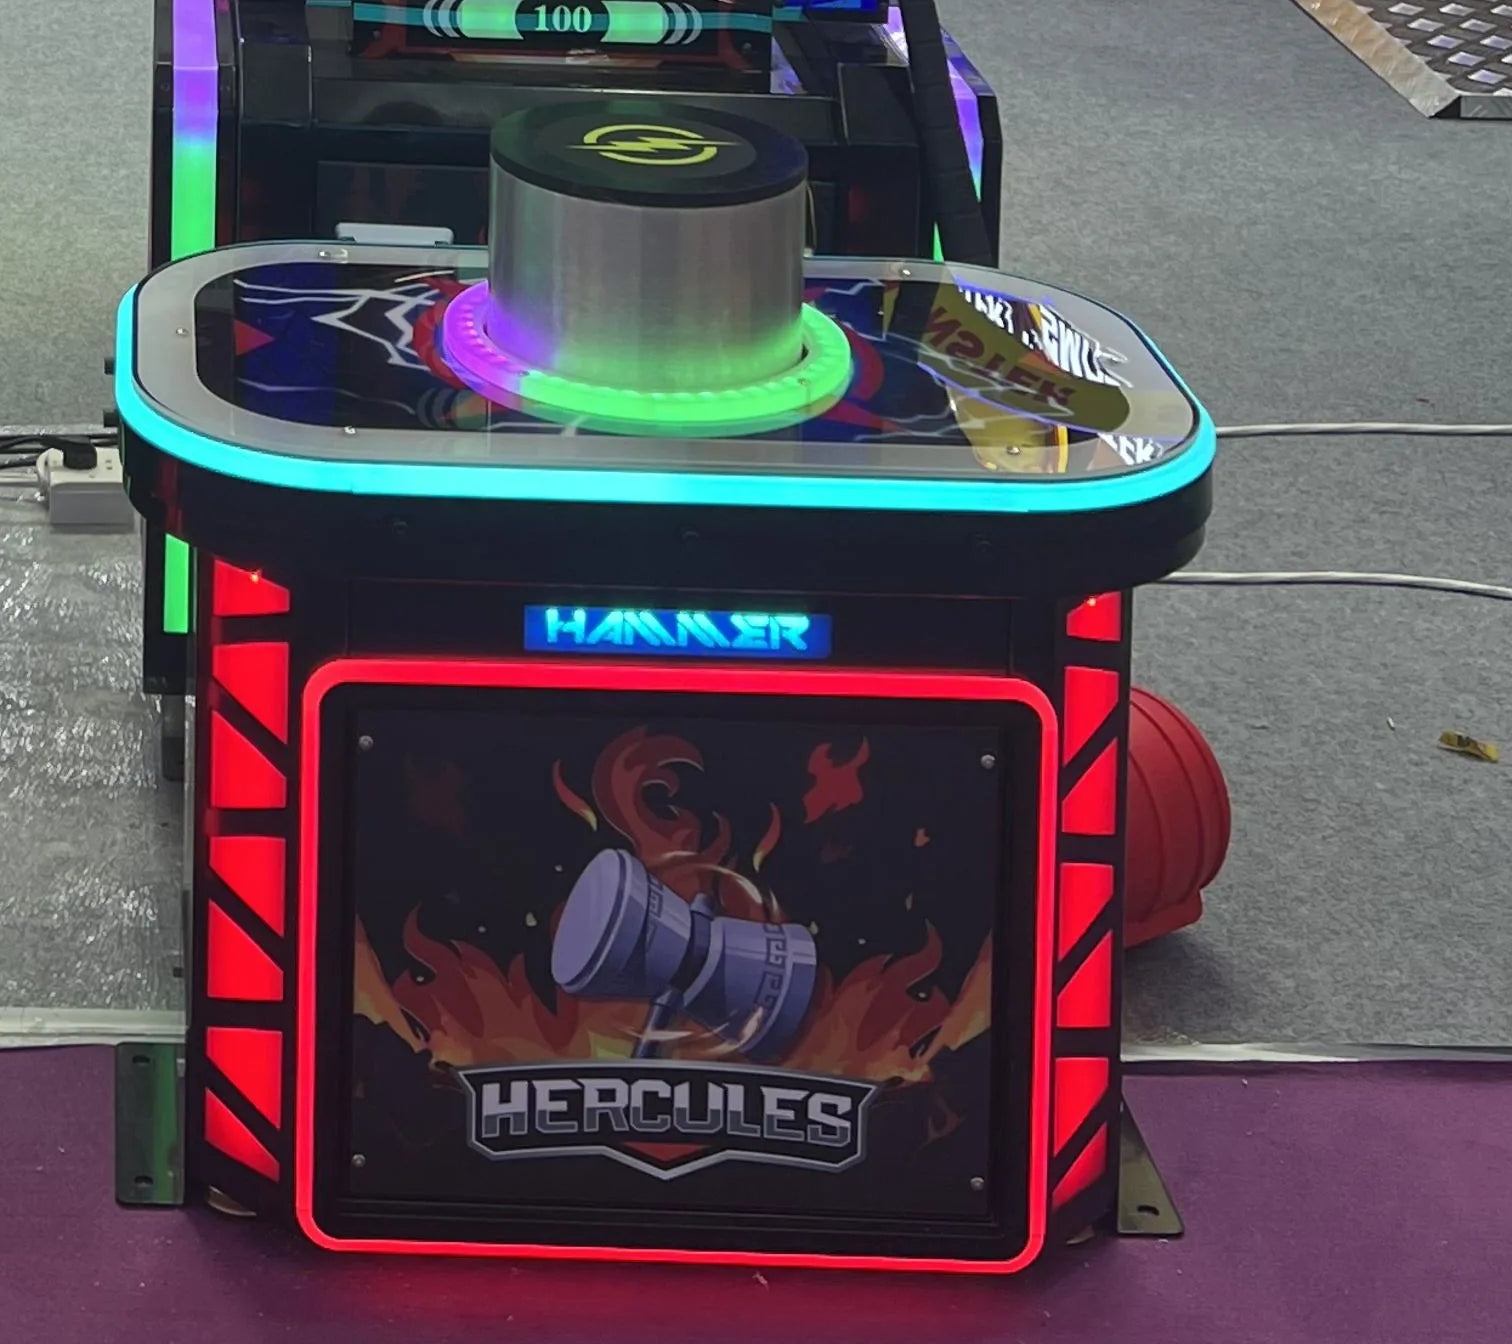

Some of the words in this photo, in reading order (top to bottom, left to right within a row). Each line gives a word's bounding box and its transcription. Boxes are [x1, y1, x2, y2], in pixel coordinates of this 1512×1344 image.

[533, 4, 593, 33] 100
[544, 607, 811, 651] HAMMER
[481, 1077, 852, 1148] HERCULES
